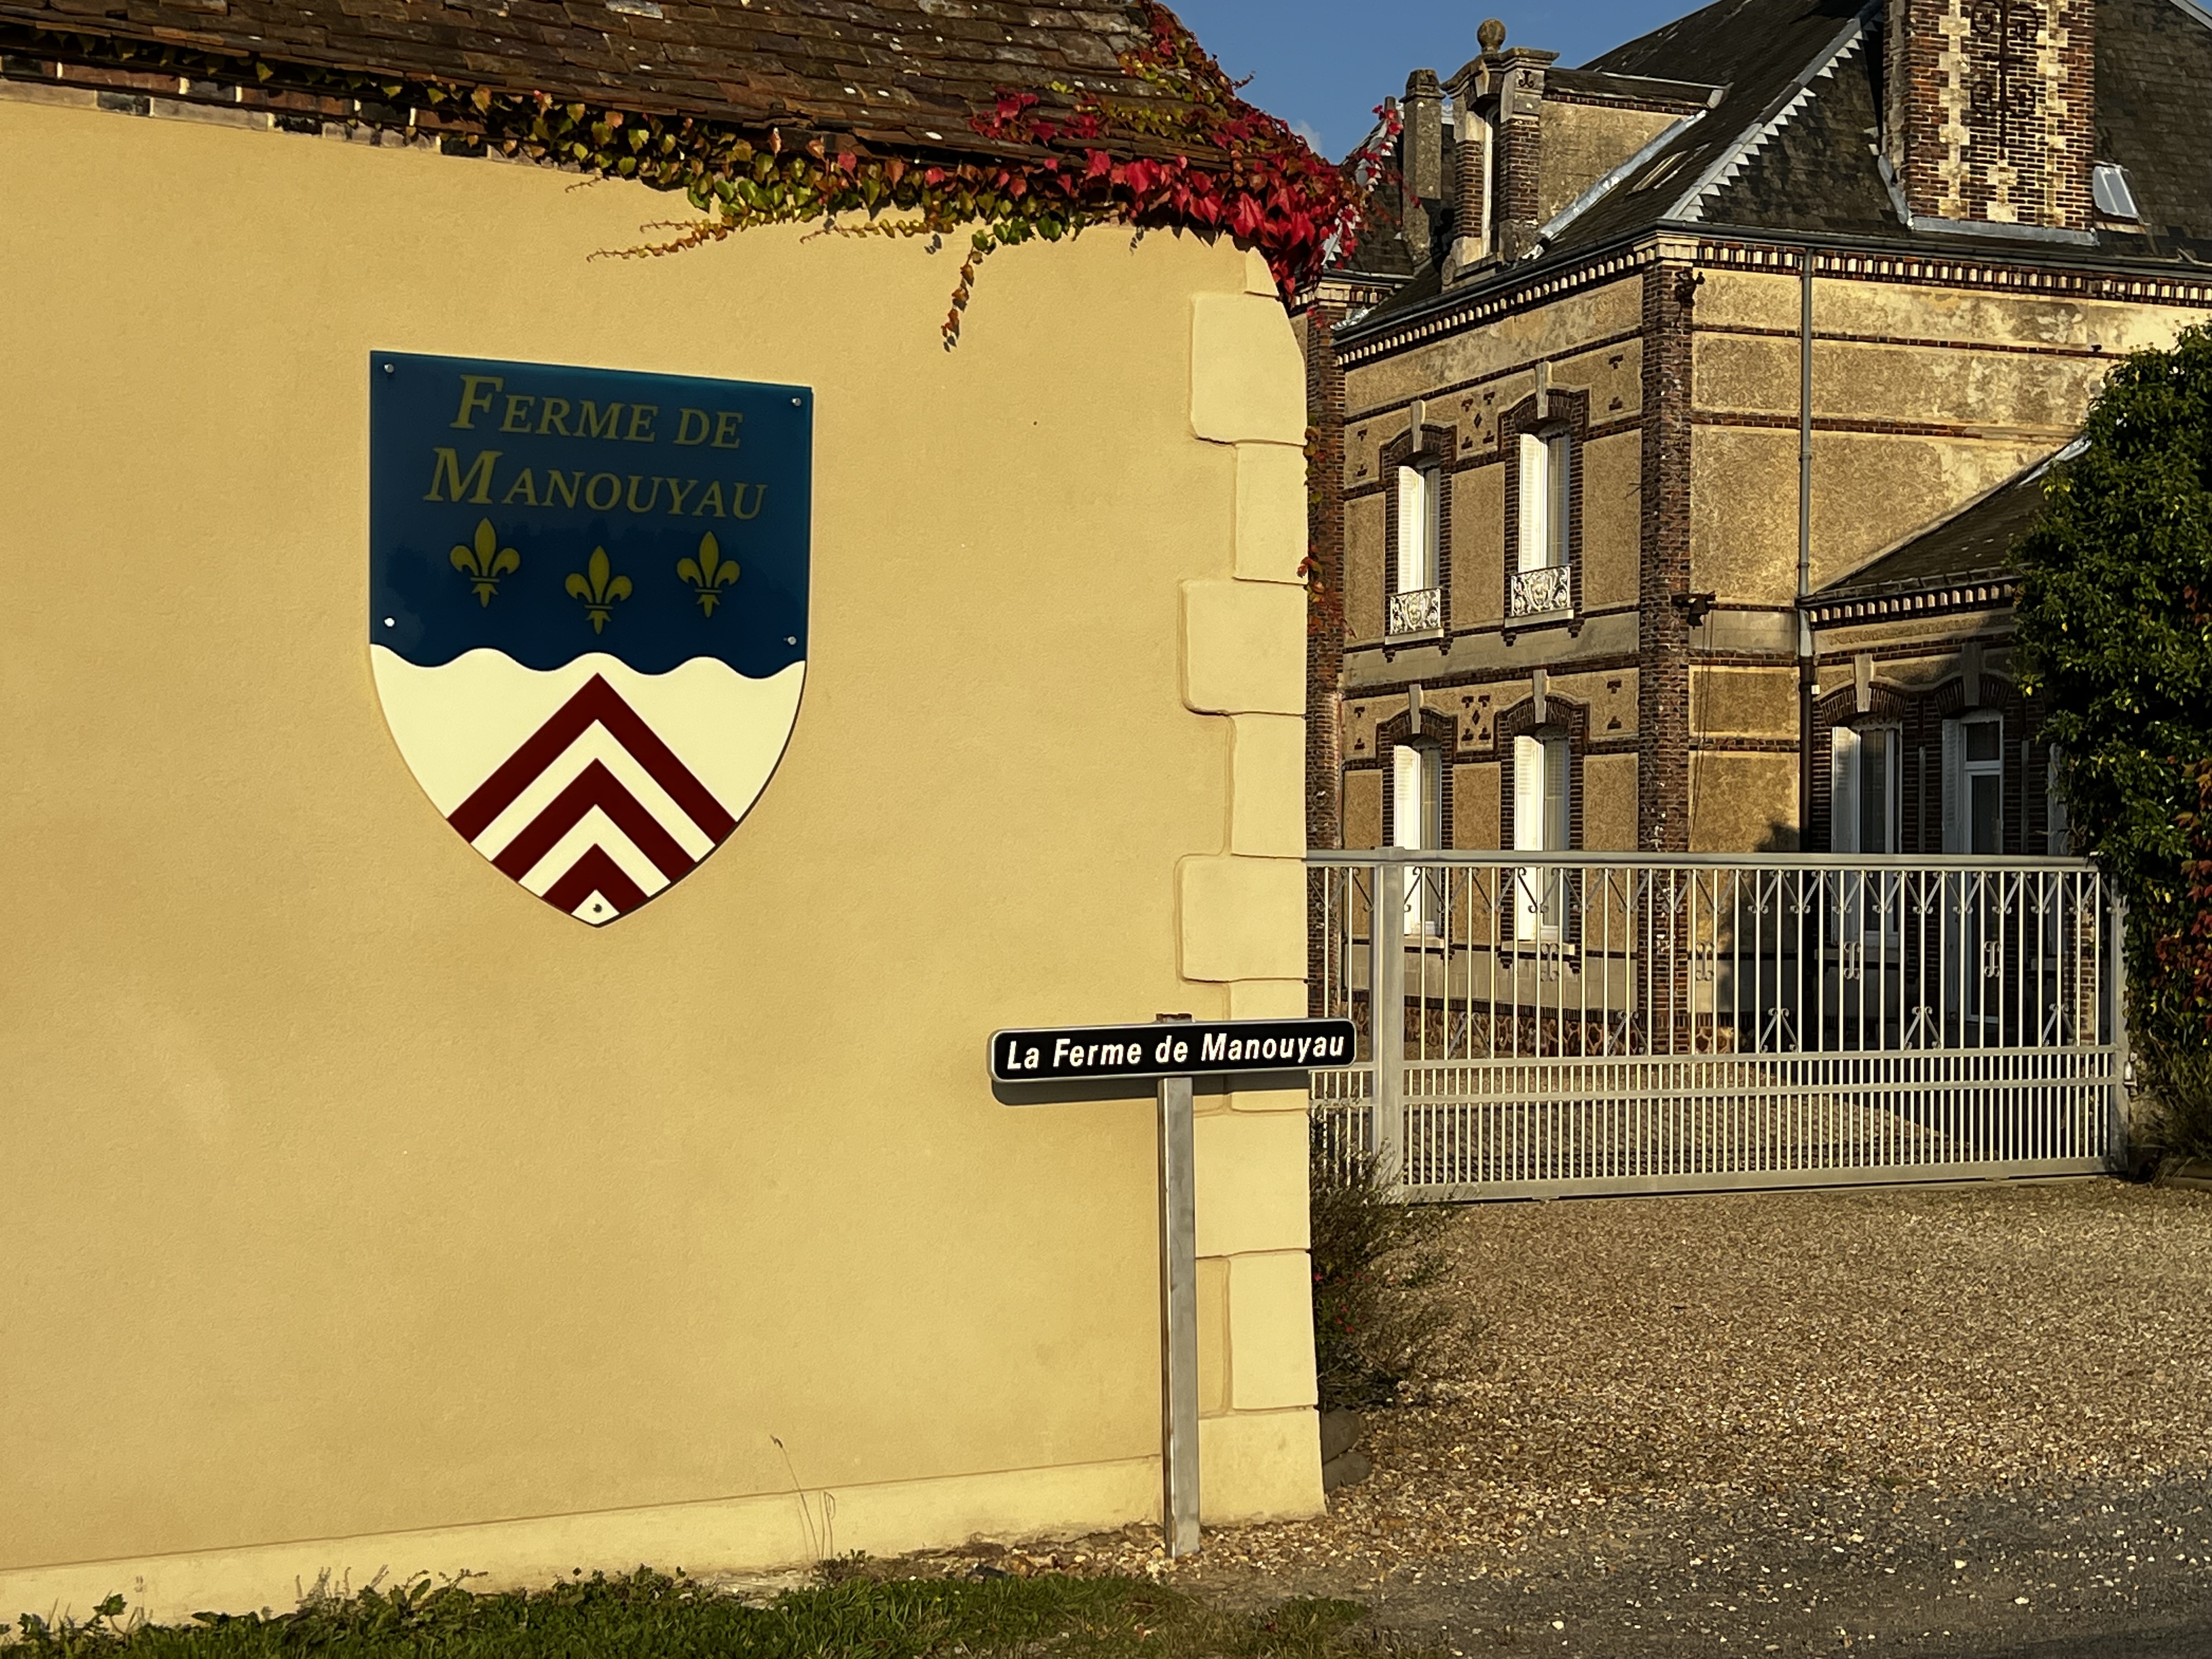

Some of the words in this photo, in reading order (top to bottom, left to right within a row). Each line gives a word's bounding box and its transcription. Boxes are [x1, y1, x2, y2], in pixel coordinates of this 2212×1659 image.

[449, 374, 659, 443] FERME
[673, 408, 744, 449] DE
[423, 447, 768, 520] MANOUYAU
[1007, 1041, 1039, 1069] La
[1053, 1039, 1142, 1067] Ferme
[1155, 1035, 1188, 1063] de
[1201, 1033, 1345, 1063] Manouyau
